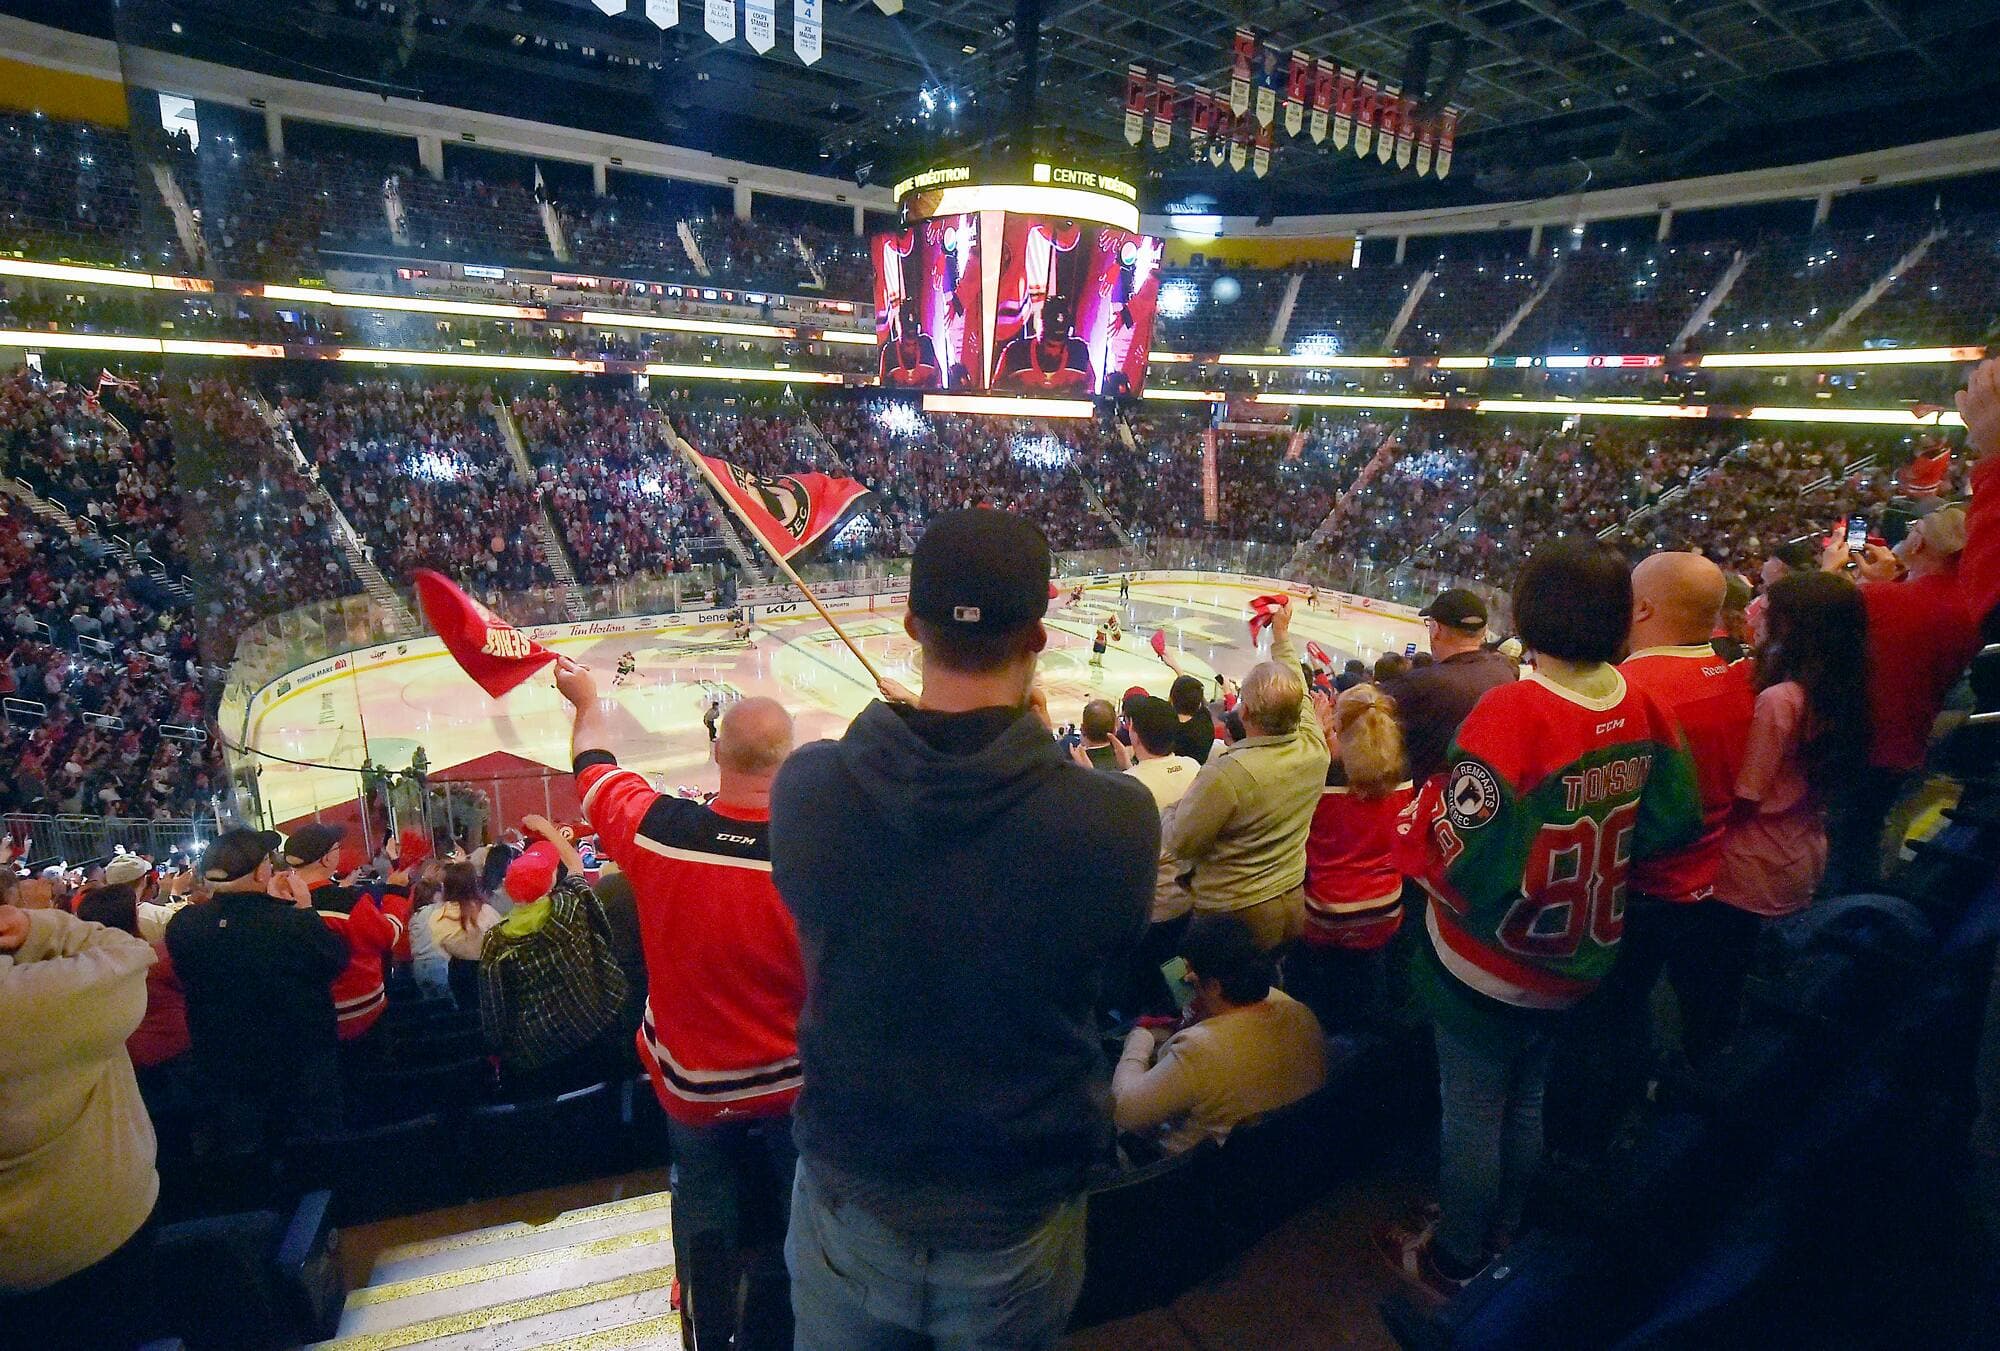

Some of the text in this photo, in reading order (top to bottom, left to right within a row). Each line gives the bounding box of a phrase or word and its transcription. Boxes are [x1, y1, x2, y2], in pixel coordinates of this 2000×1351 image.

[804, 8, 812, 18] 4
[914, 166, 970, 188] VIDÉOTRON
[1053, 168, 1097, 187] CENTRE
[767, 603, 798, 615] KIA
[569, 624, 589, 637] Tim
[588, 623, 626, 635] Hortons
[1596, 718, 1625, 735] CCM
[1460, 765, 1496, 808] REMPARTS
[716, 833, 756, 845] CCM
